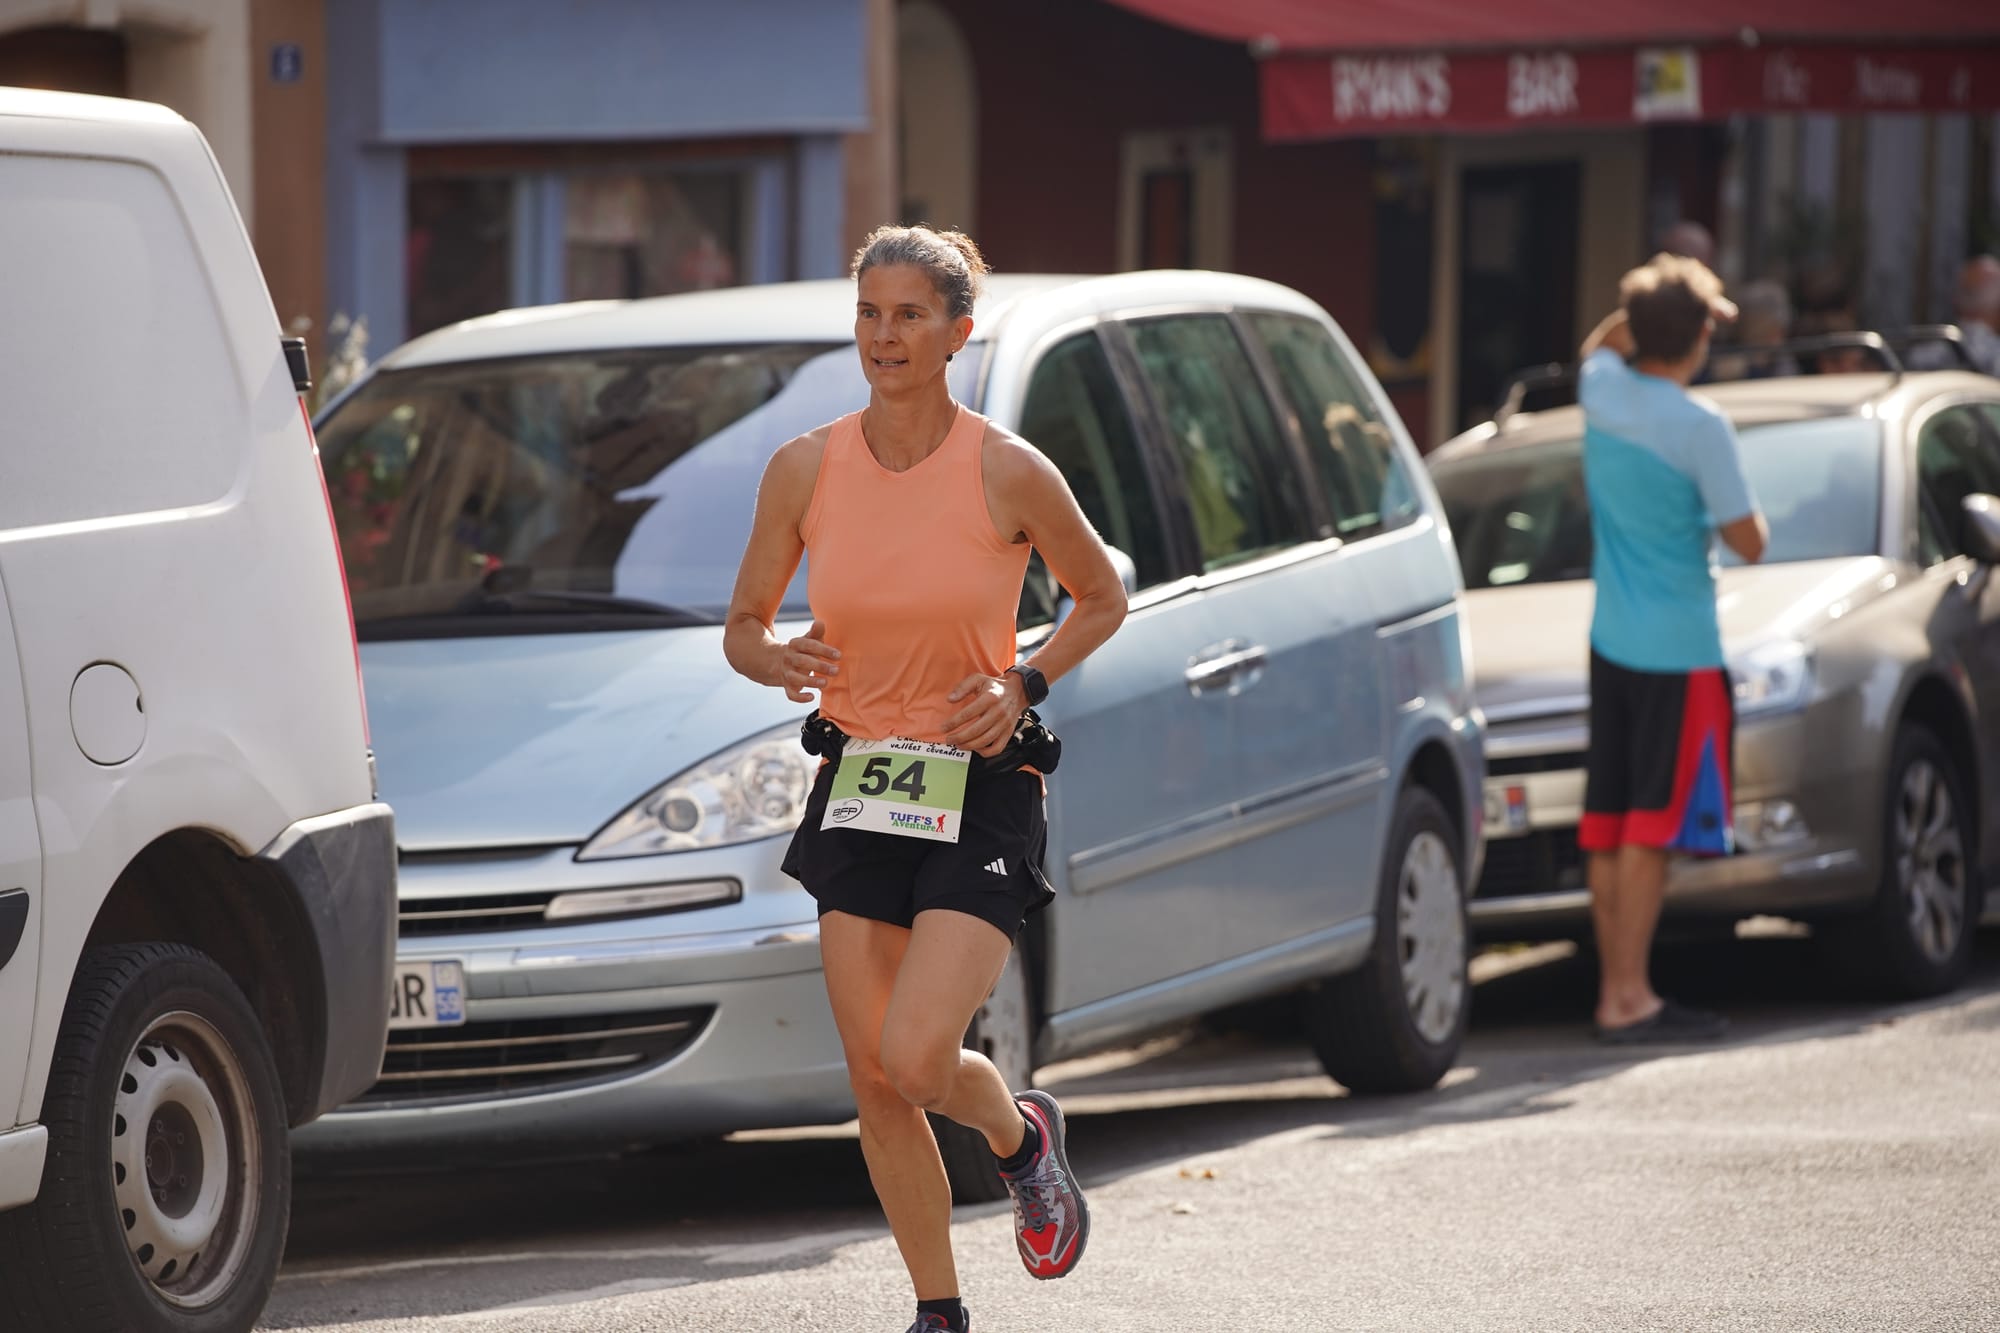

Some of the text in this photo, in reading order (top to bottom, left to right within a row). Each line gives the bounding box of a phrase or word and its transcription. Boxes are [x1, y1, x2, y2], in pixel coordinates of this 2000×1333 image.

[1332, 53, 1579, 119] RYAN'S BAR
[858, 757, 926, 801] 54
[832, 807, 858, 817] BFP
[889, 812, 933, 825] TUFF'S
[892, 819, 936, 832] Aventure
